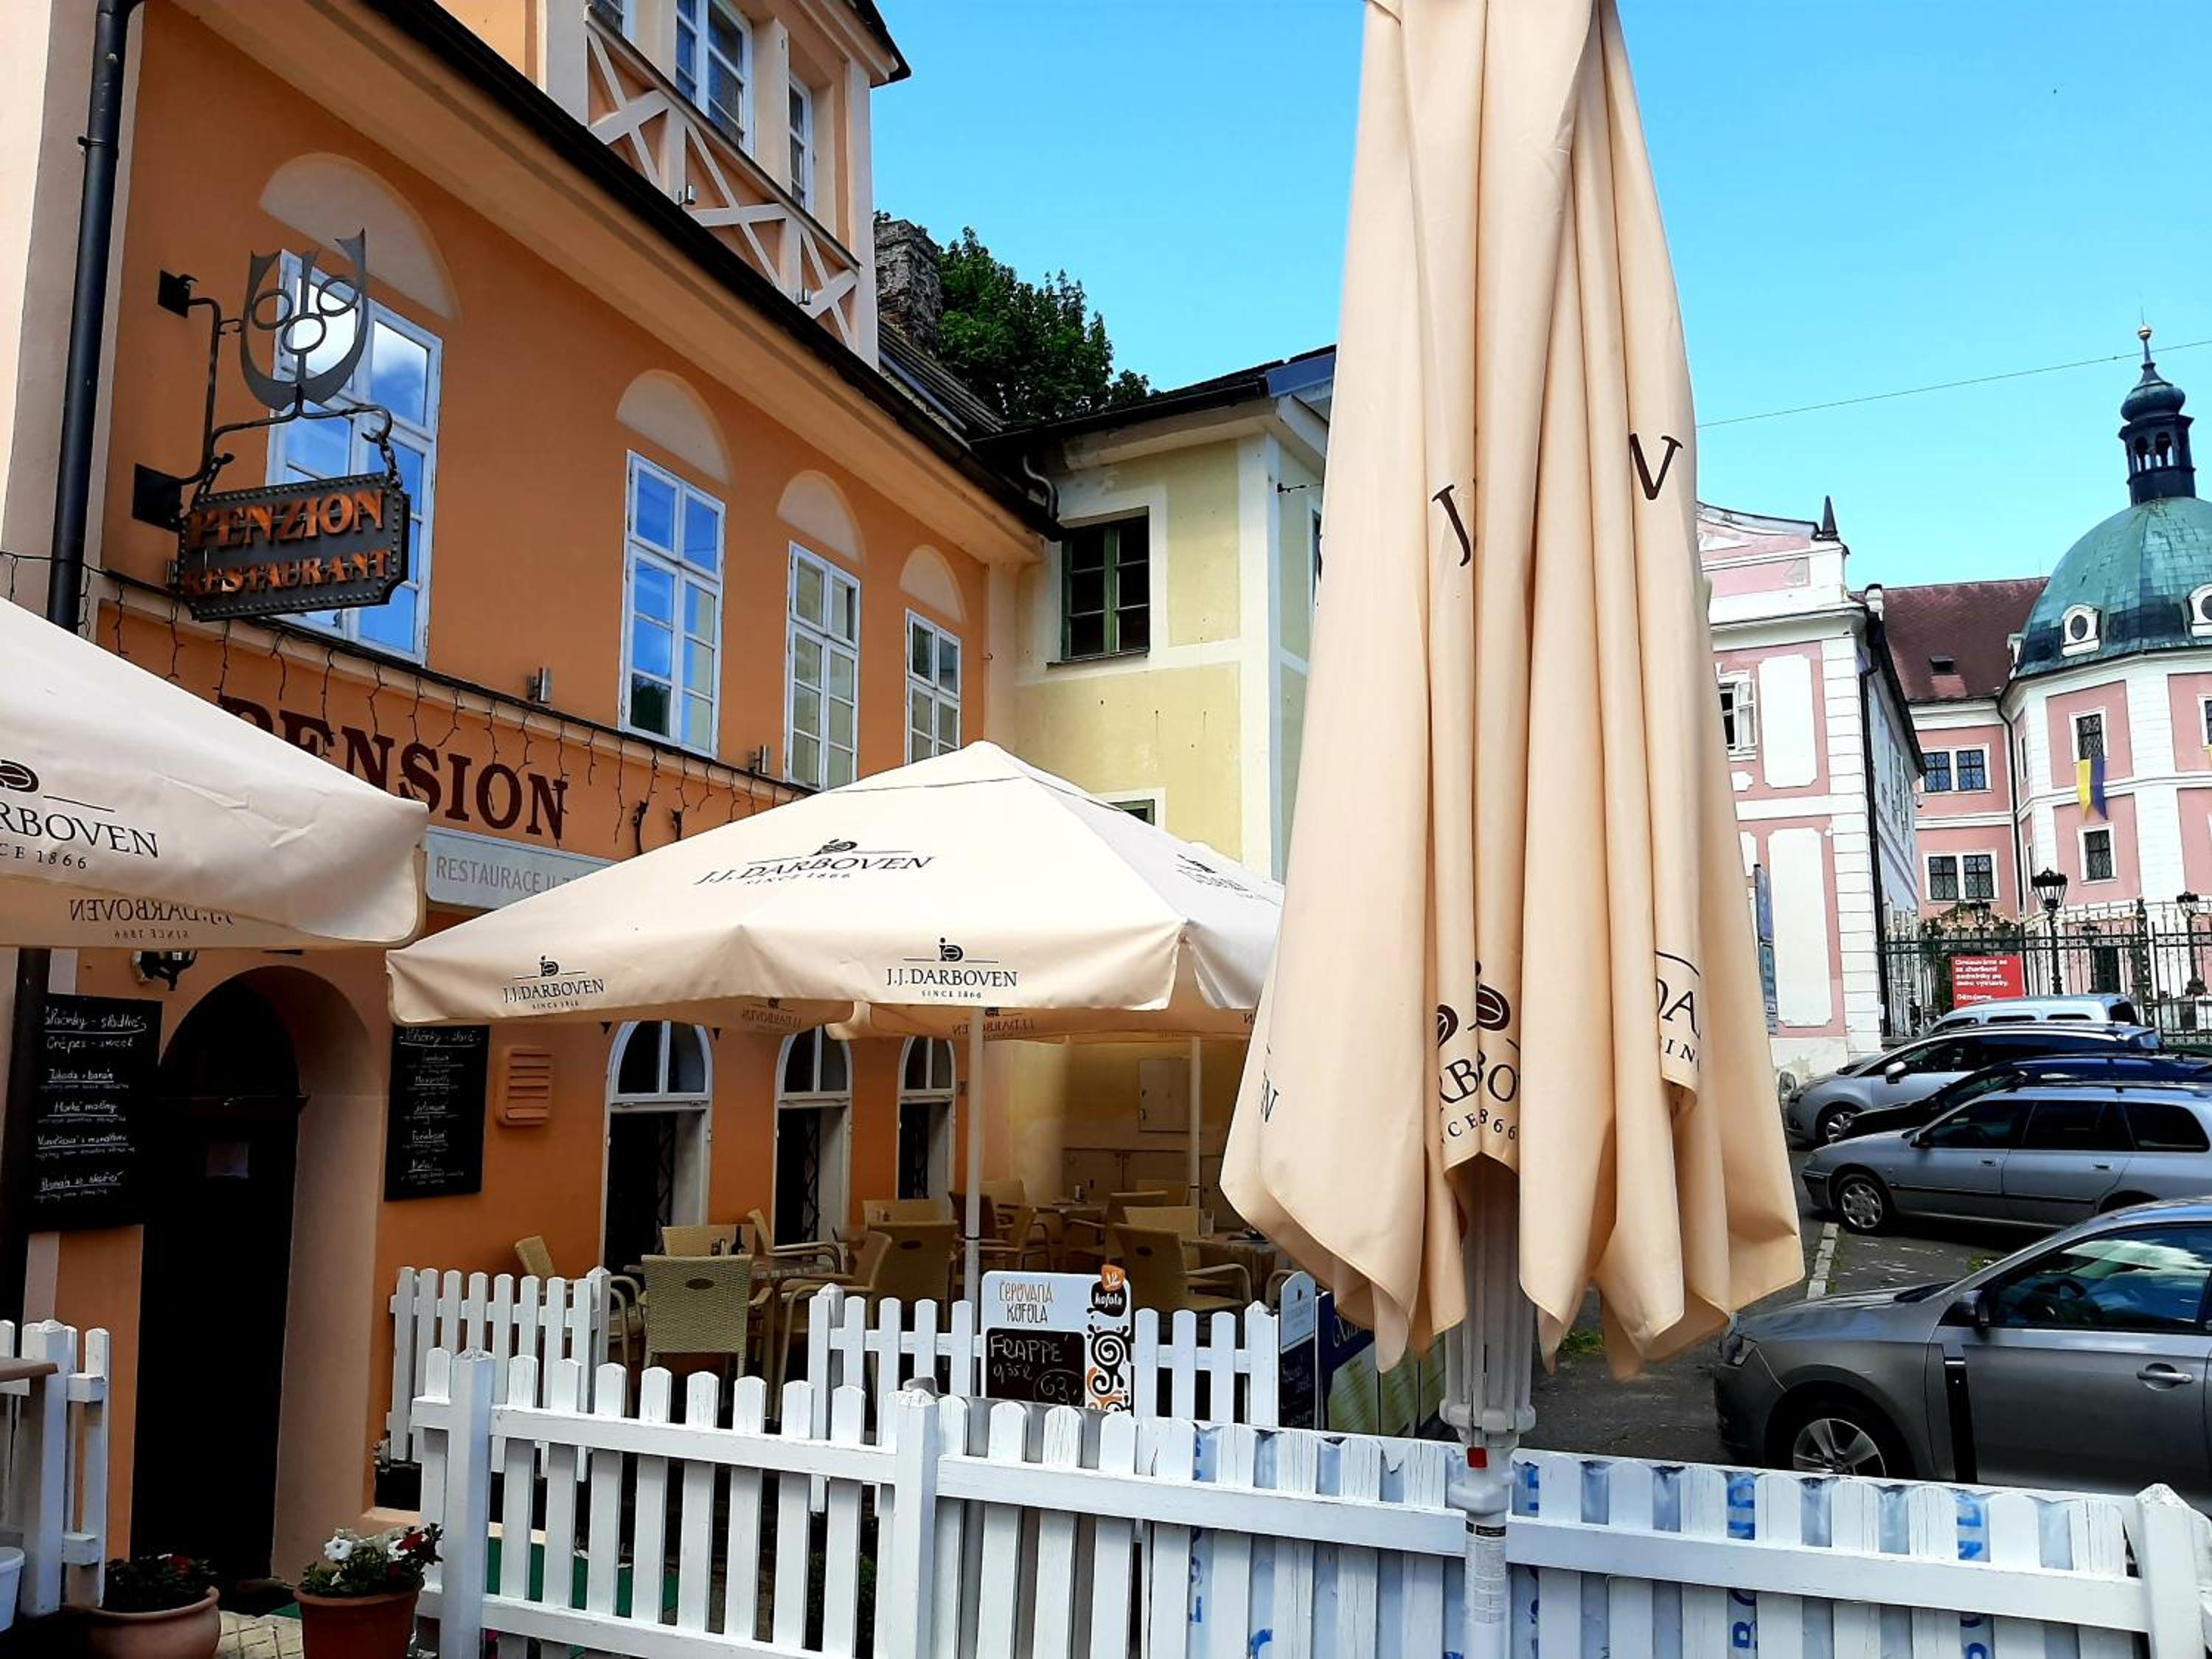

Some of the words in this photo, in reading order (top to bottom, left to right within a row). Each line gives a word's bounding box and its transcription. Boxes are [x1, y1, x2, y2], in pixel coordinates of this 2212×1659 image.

[189, 487, 384, 548] PENZION
[37, 850, 88, 870] 1866
[694, 856, 935, 885] J.J.DARBOVEN
[436, 855, 543, 893] RESTAURACE
[886, 968, 1018, 987] J.J.DARBOVEN
[504, 978, 605, 1004] J.J.DARBOVEN
[1006, 1303, 1048, 1324] KOFOLA
